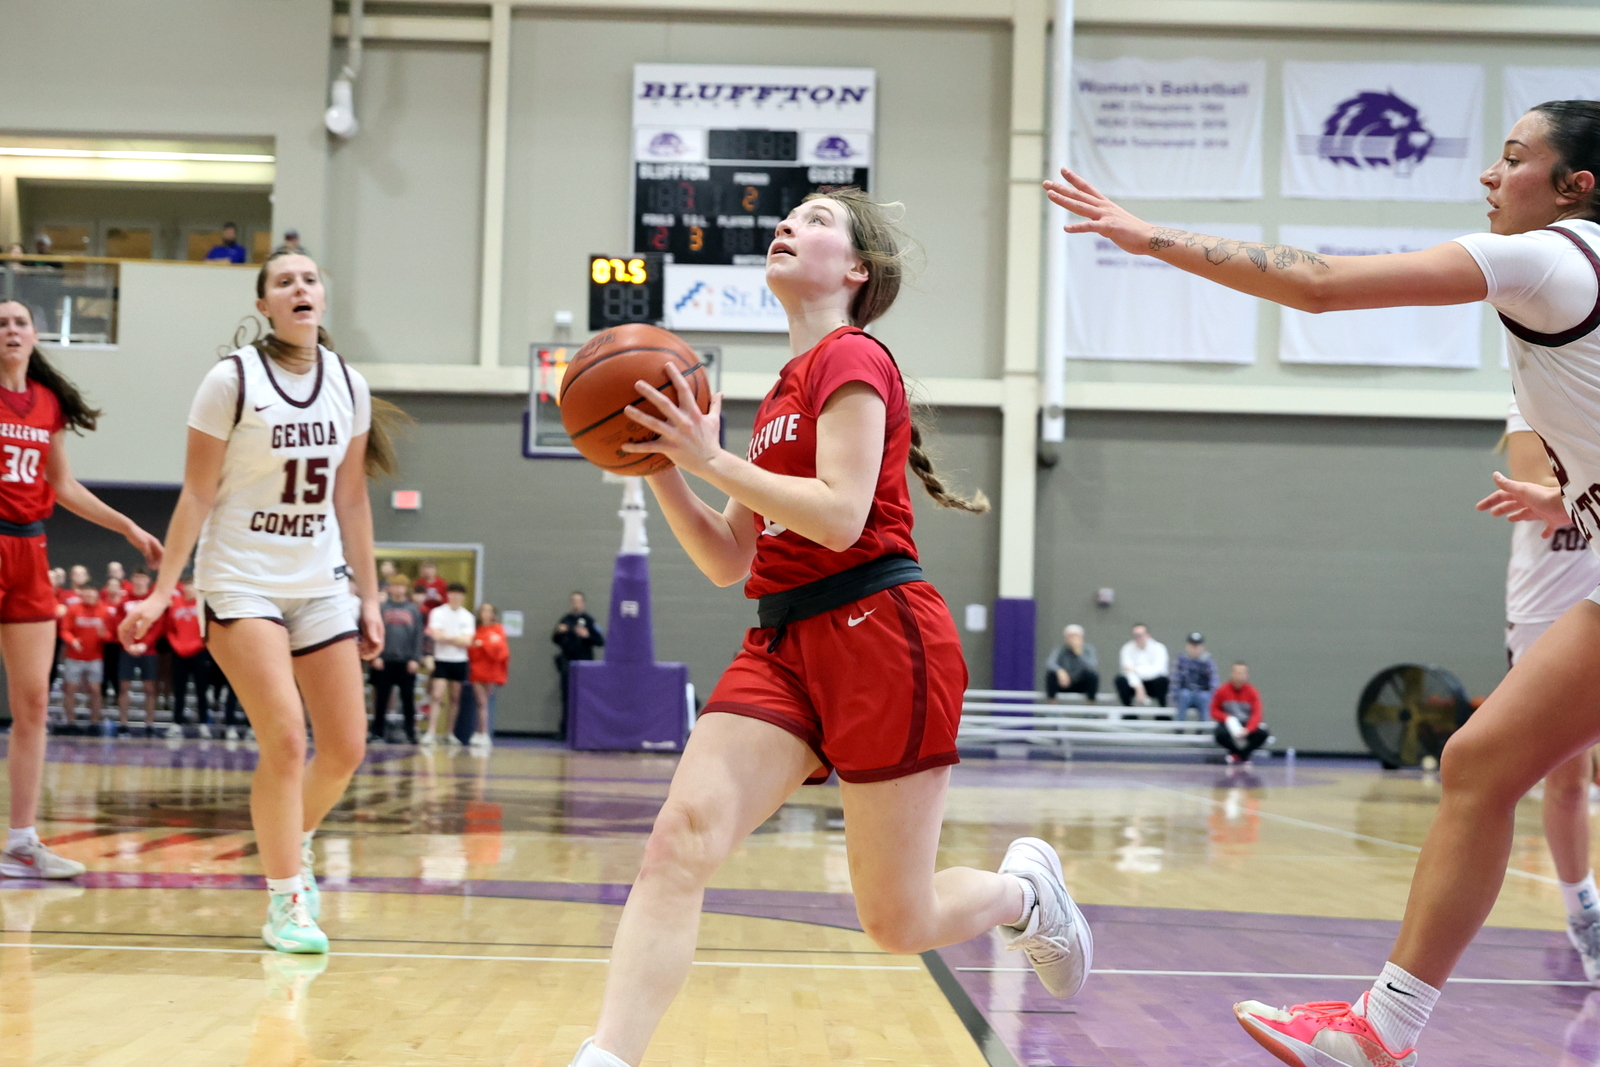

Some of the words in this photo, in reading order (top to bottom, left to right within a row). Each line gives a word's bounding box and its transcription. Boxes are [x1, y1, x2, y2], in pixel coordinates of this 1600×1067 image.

[639, 81, 869, 103] BLUFFTON
[1161, 81, 1247, 96] Basketball
[638, 162, 711, 181] BLUFFTON
[0, 423, 50, 444] ELLEVUE
[271, 421, 338, 449] GENOA
[746, 413, 800, 463] LLEVUE
[1, 444, 41, 484] 30
[281, 457, 330, 504] 15
